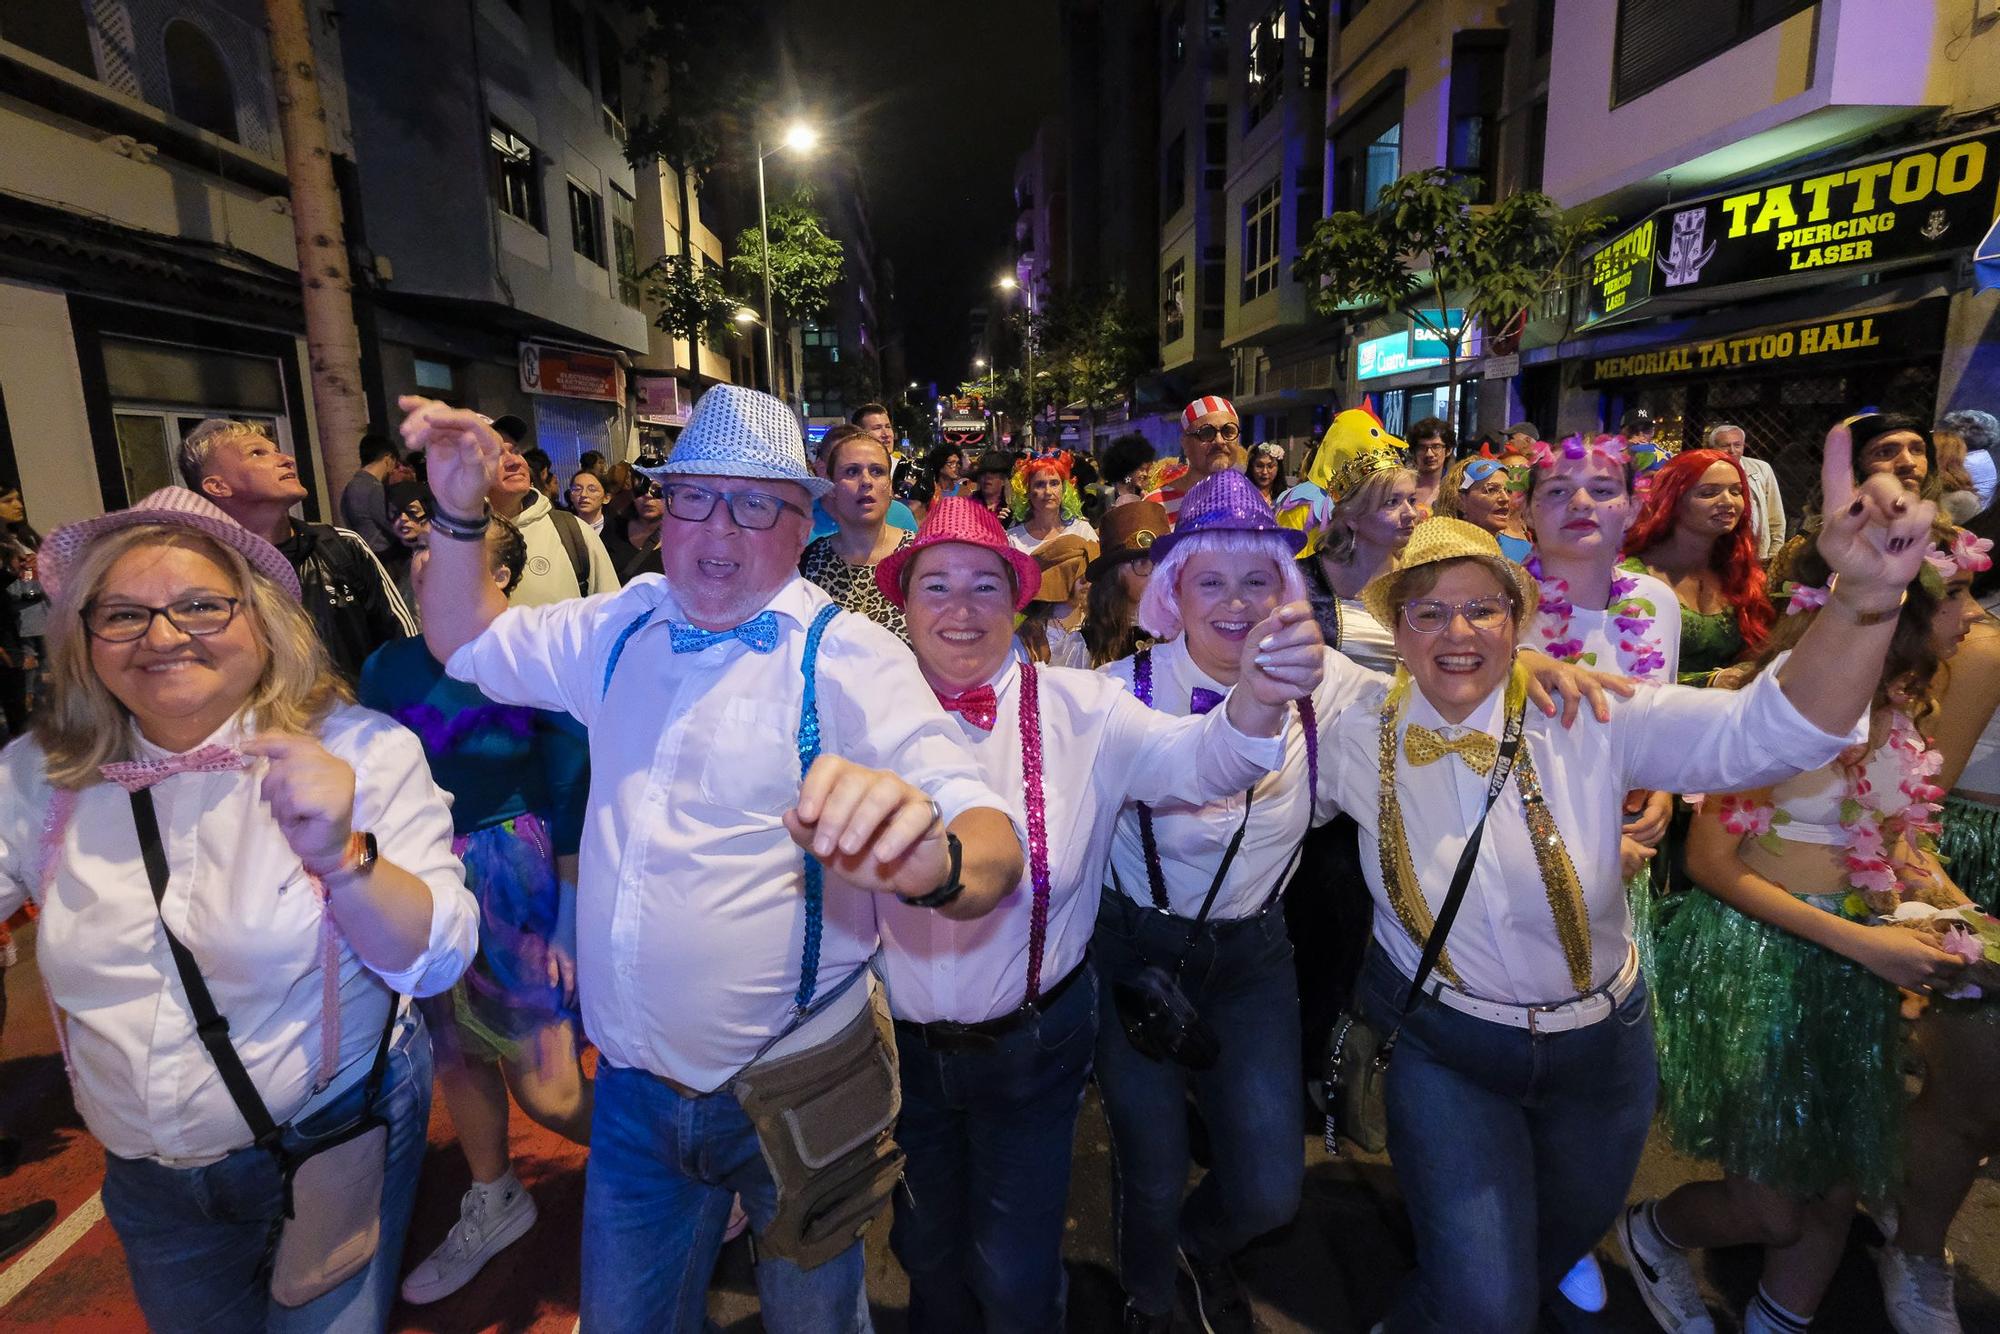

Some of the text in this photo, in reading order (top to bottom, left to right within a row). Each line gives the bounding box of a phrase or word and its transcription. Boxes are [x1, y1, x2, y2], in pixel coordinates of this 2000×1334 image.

[1722, 141, 1987, 239] TATTOO
[1777, 212, 1896, 250] PIERCING
[1789, 240, 1873, 270] LASER
[1594, 319, 1880, 380] MEMORIAL TATTOO HALL
[1489, 755, 1511, 797] BIMBA
